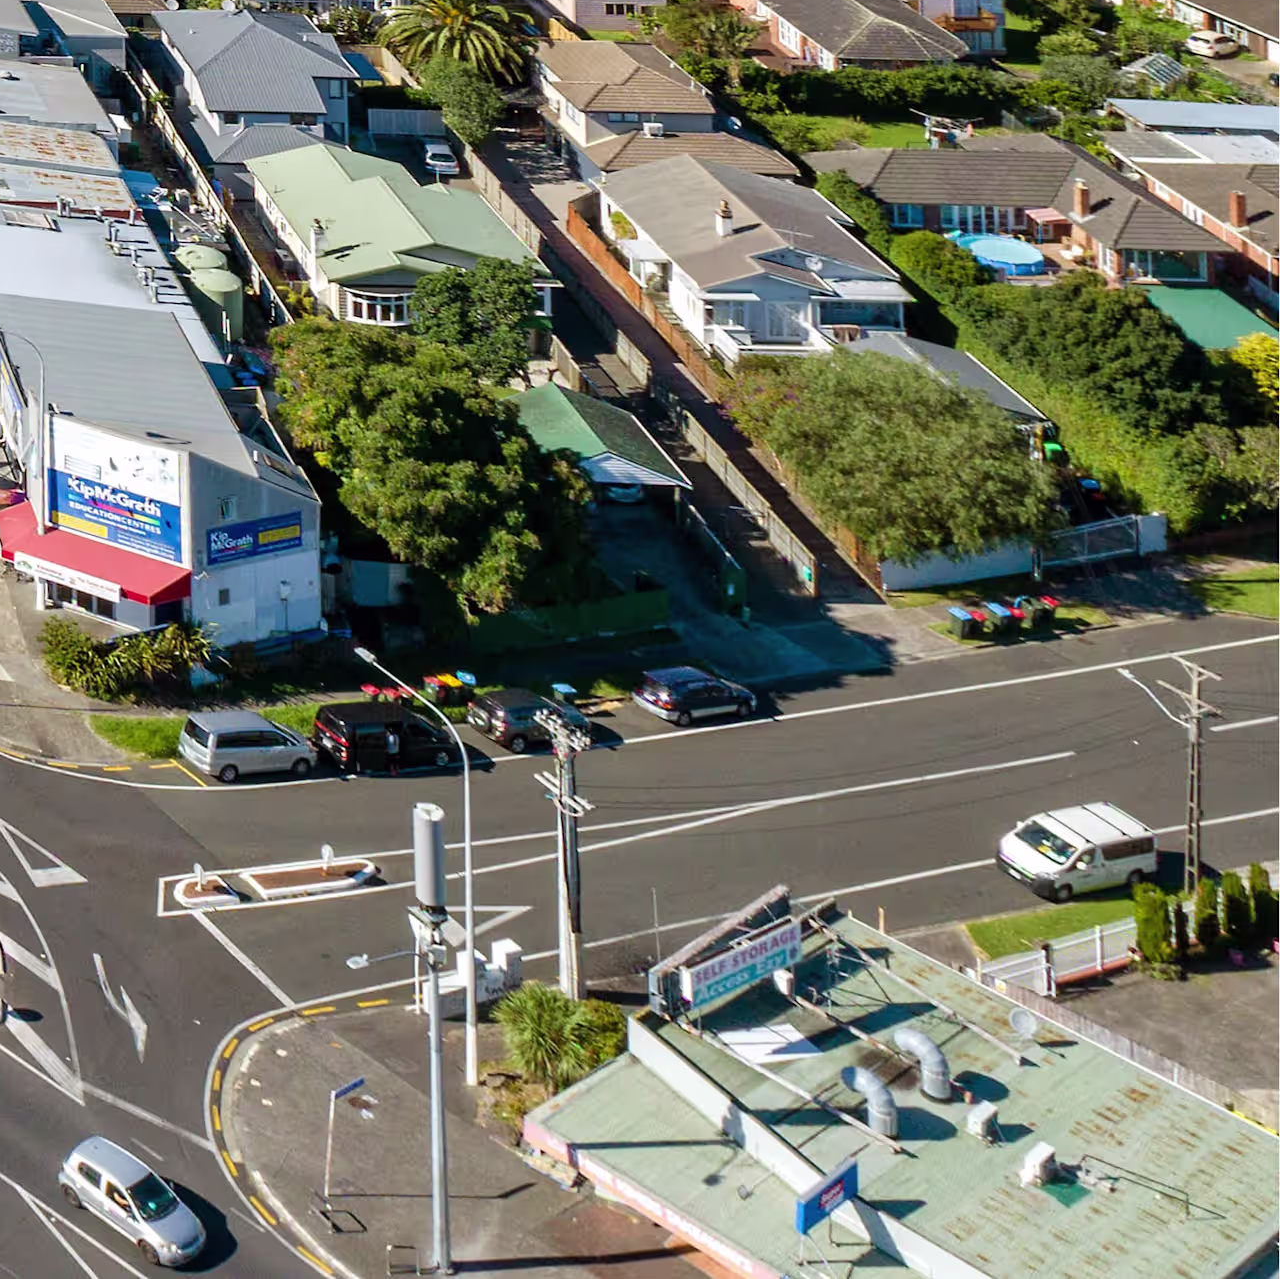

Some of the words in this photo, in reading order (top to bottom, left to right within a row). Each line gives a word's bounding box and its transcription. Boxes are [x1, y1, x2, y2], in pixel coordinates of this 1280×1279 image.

[210, 530, 228, 544] Kip
[695, 957, 728, 985] SELF
[732, 927, 797, 969] STORAGE
